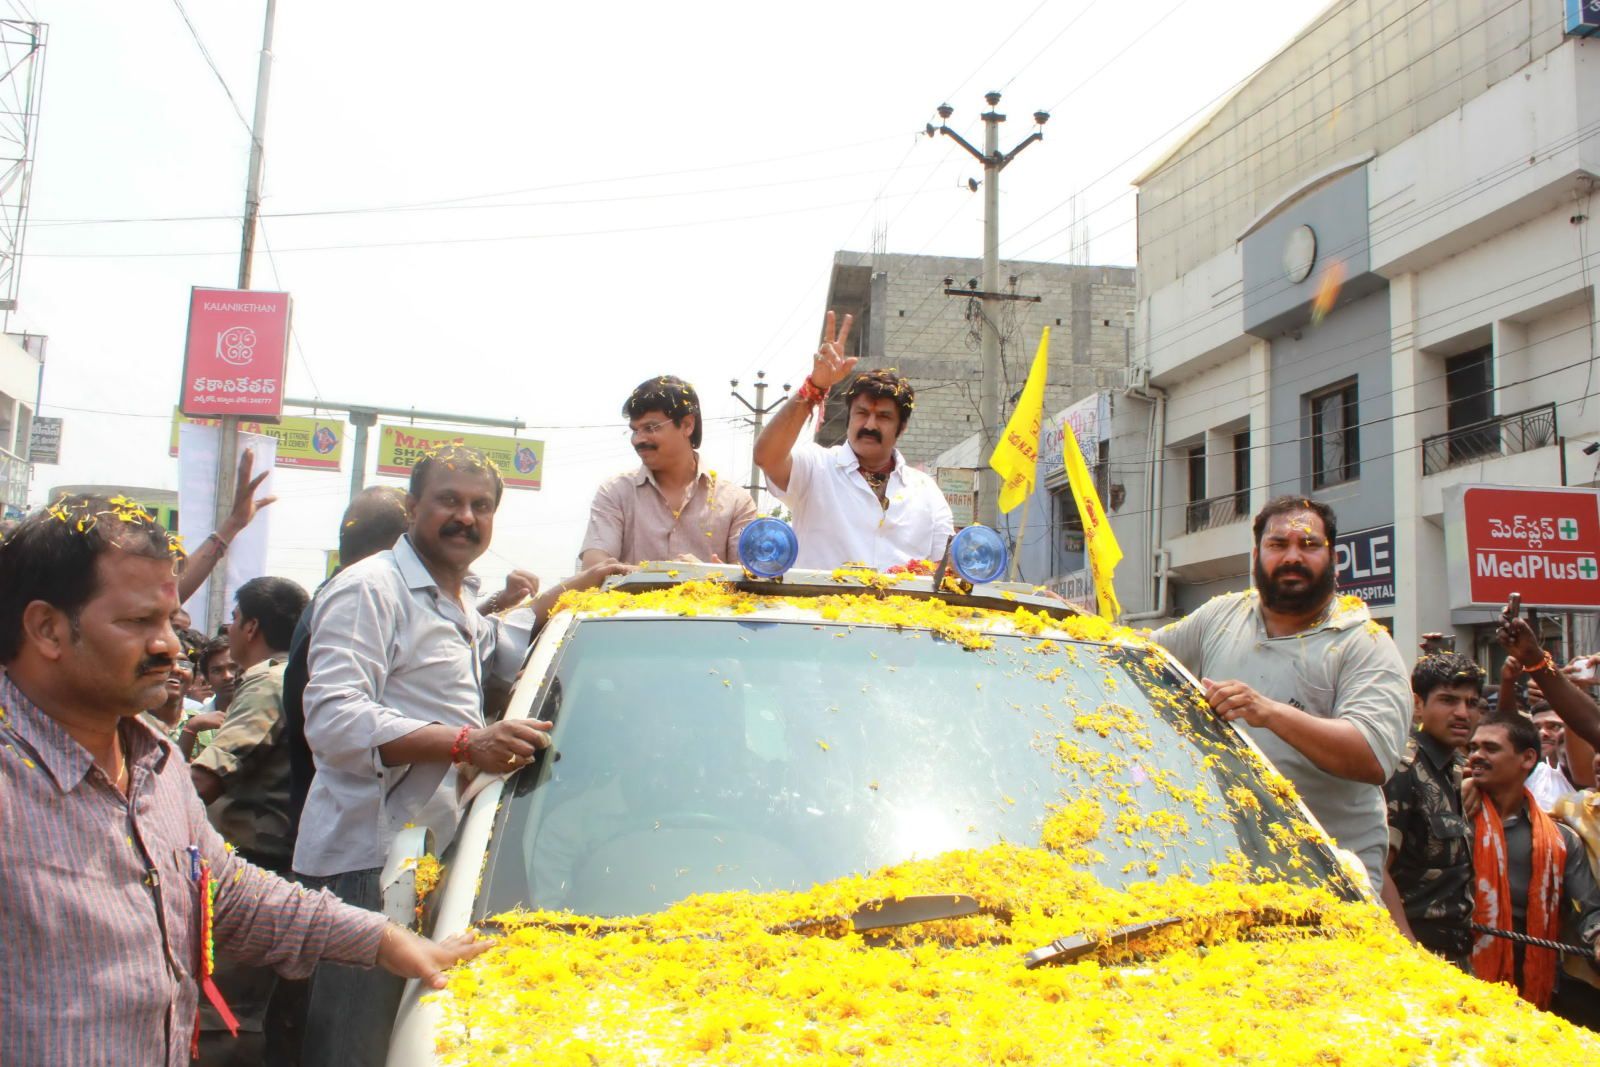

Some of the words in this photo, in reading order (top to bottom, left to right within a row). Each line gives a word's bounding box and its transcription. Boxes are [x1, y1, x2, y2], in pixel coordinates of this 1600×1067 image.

[203, 302, 277, 313] KALANIKETHAN
[394, 430, 464, 451] MA
[1334, 535, 1391, 578] PLE
[1476, 553, 1578, 579] MedPlus
